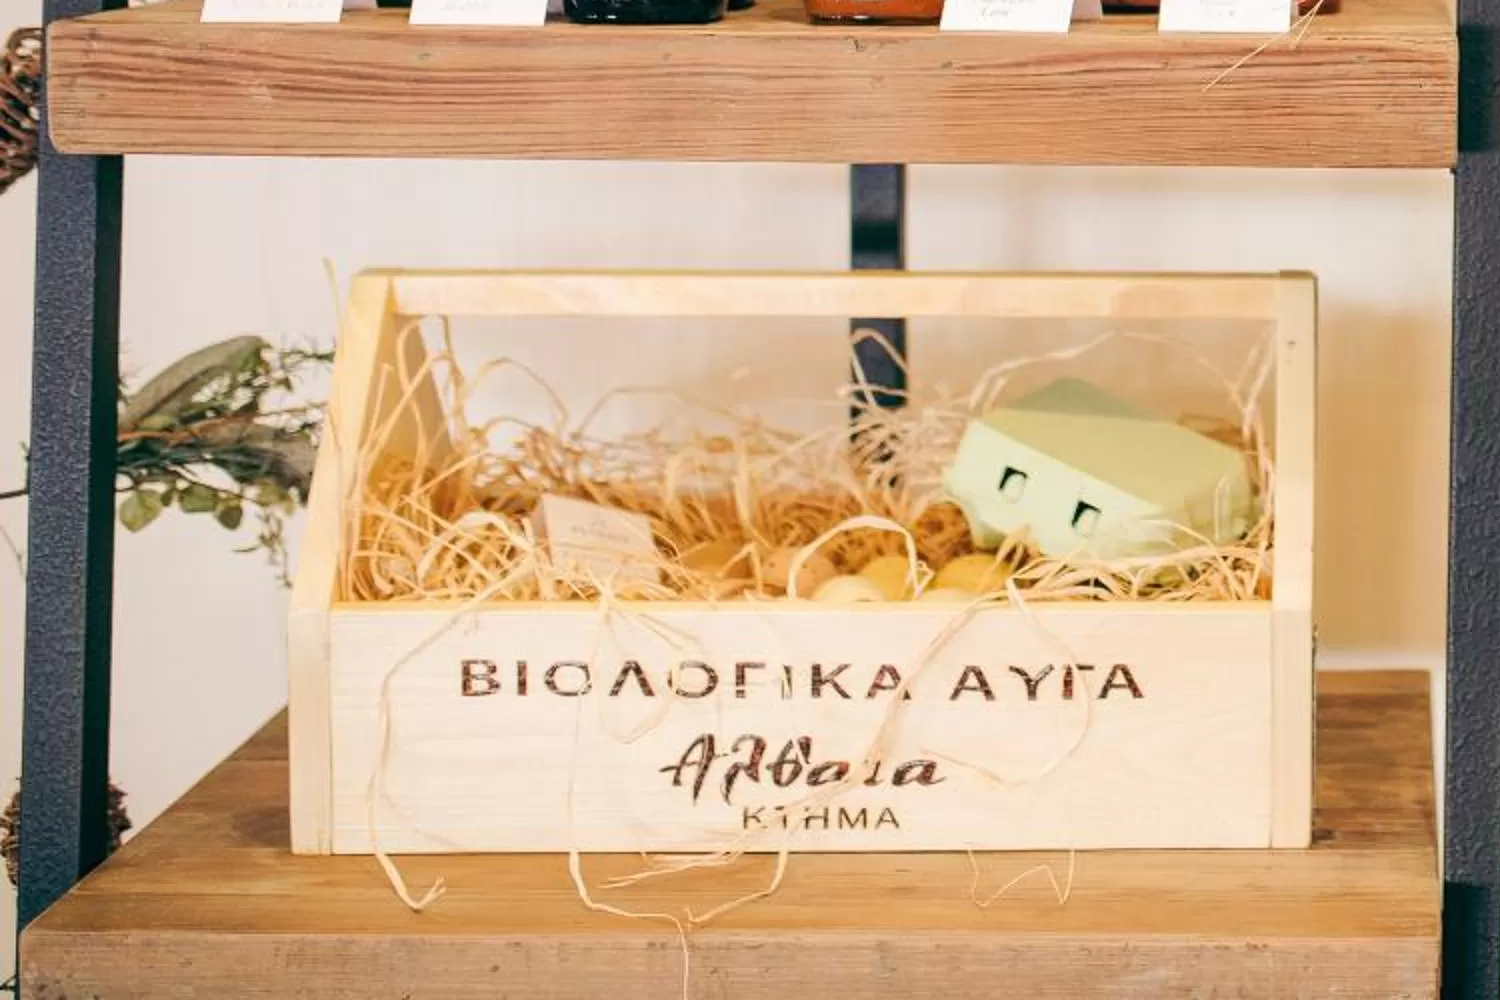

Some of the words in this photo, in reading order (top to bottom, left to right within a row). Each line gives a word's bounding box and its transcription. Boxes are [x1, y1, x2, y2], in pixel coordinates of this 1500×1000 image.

[459, 658, 912, 701] ΒΙΟΛΟΓΙΚΑ
[949, 663, 1145, 702] ΑΥΓΑ
[742, 805, 901, 831] ΚΤΗΜΑ
